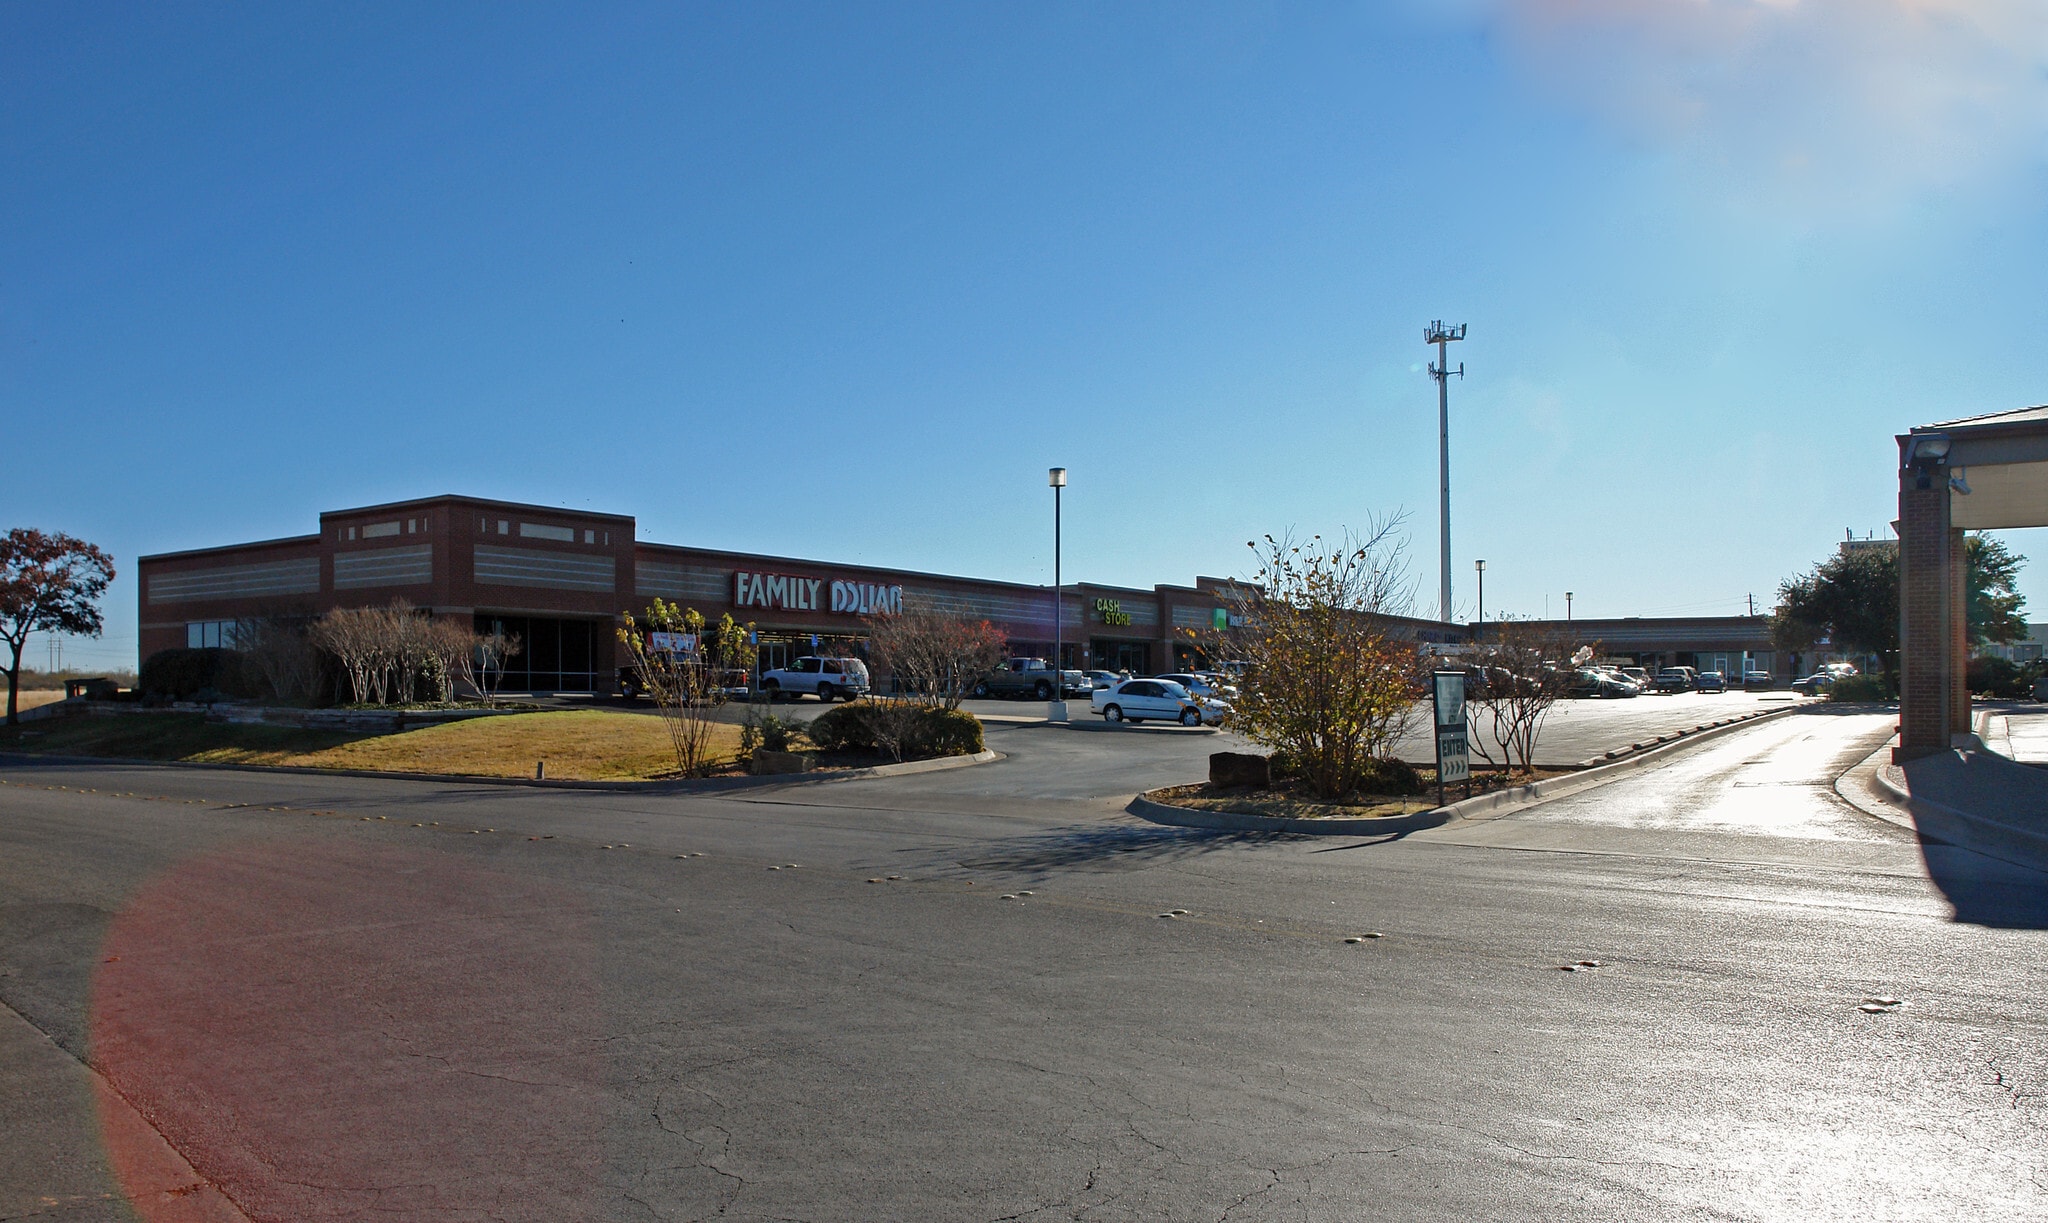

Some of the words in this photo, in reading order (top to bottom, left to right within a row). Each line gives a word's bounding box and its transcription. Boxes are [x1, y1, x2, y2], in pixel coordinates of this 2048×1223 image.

[735, 571, 821, 611] FAMILY
[830, 579, 903, 614] DOLLAR
[1097, 598, 1120, 612] CASH
[1105, 611, 1132, 626] STORE
[1442, 738, 1466, 757] ENTER
